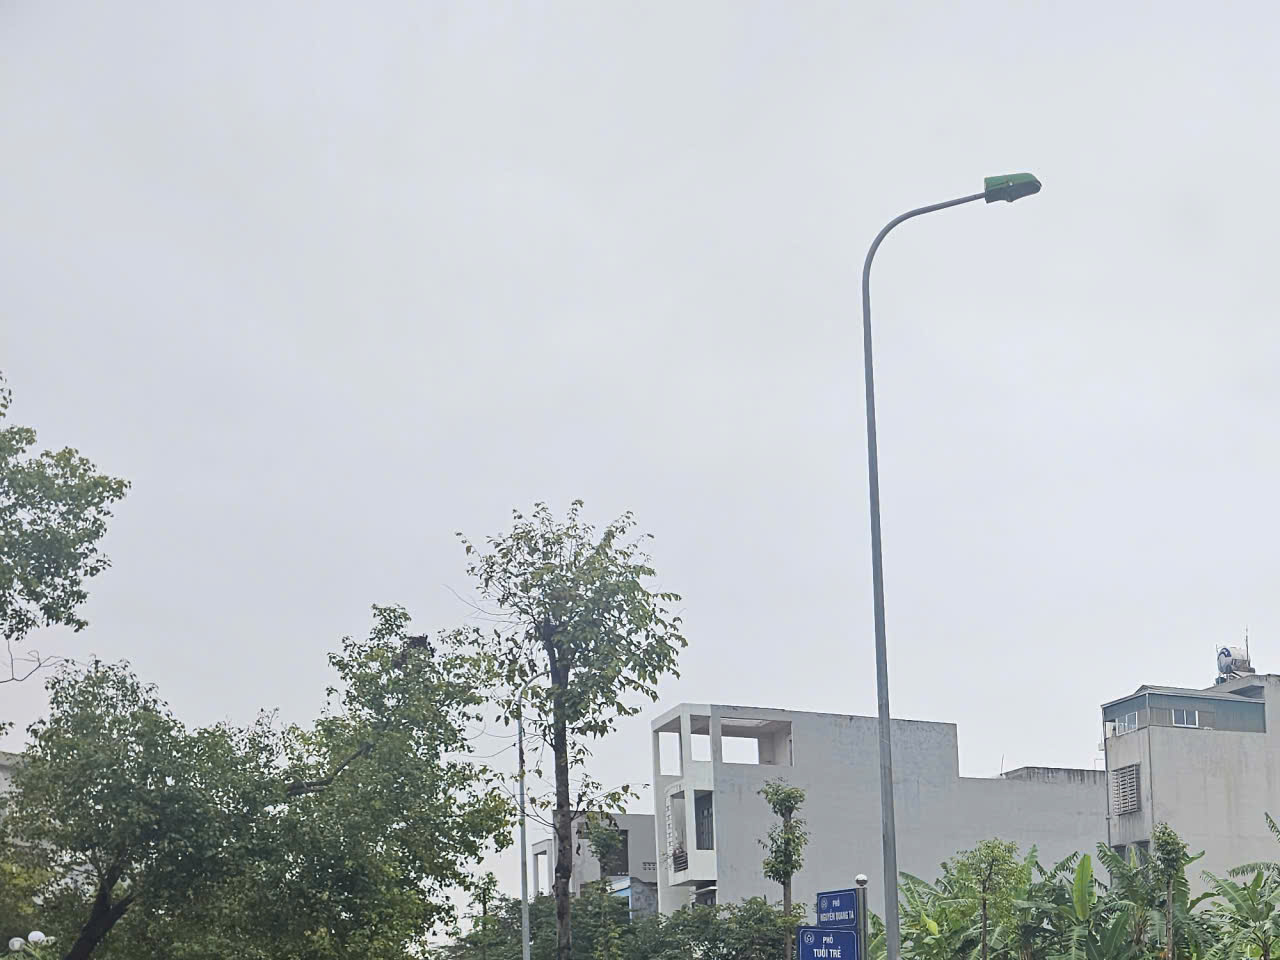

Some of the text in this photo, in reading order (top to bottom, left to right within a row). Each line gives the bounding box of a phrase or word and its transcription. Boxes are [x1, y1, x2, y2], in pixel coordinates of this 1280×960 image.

[823, 934, 833, 944] PHỐ
[813, 944, 841, 958] TUỔI TRẺ
